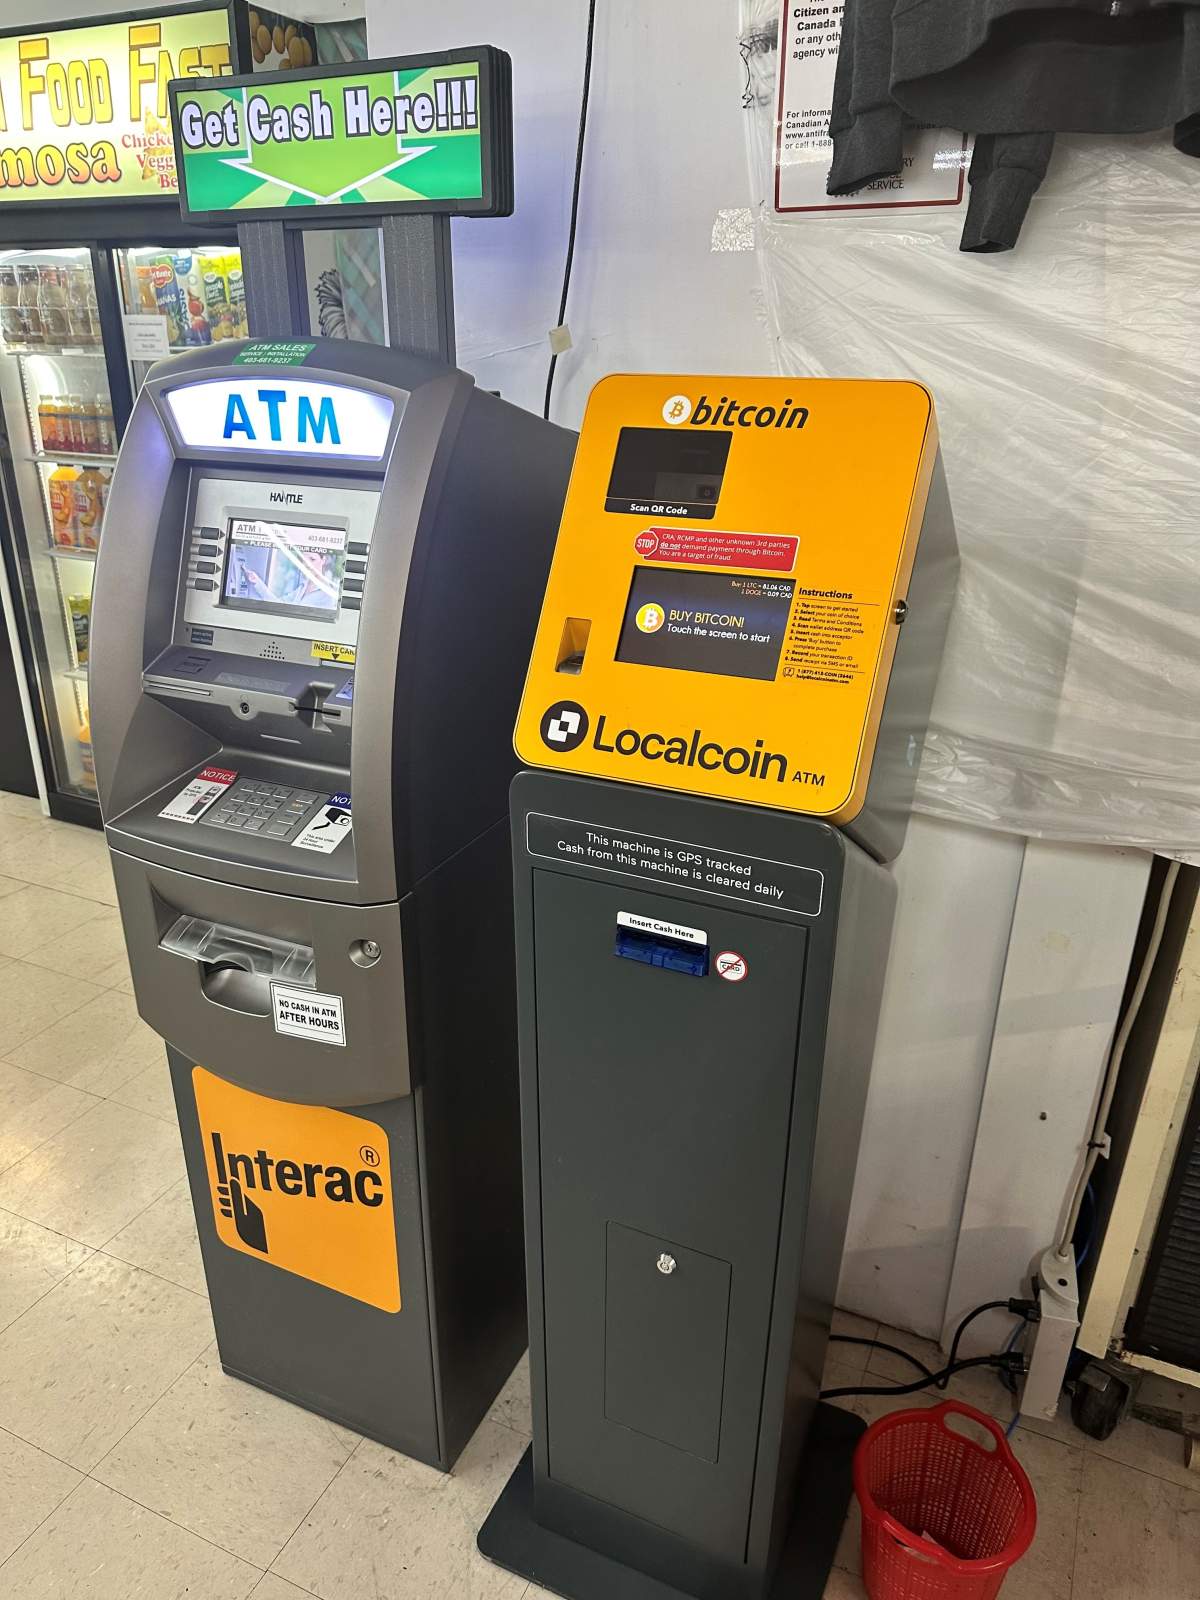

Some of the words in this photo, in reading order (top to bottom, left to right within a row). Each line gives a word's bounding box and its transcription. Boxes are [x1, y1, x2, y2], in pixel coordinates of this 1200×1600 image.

[794, 7, 829, 17] Citizen
[797, 19, 836, 31] Canada
[807, 35, 823, 45] any
[793, 48, 825, 60] agency
[828, 45, 838, 54] wi
[19, 37, 113, 130] FOOD
[180, 99, 239, 149] Get
[248, 89, 334, 144] Cash
[343, 76, 478, 138] Here!!!
[786, 119, 821, 128] Canadian
[795, 141, 809, 149] call
[867, 179, 904, 190] SERVICE
[223, 389, 341, 444] ATM
[690, 396, 809, 428] bitcoin
[630, 503, 649, 512] Scan
[651, 505, 664, 514] QR
[666, 506, 688, 515] Code
[236, 524, 256, 532] ATM
[637, 539, 655, 548] STOP
[736, 547, 760, 555] through
[799, 588, 853, 599] Instructions
[669, 610, 693, 621] BUY
[694, 612, 745, 628] BITCOIN!
[667, 623, 694, 634] Touch
[694, 626, 707, 636] the
[708, 629, 737, 640] screen
[739, 632, 748, 641] to
[750, 633, 770, 643] start
[313, 643, 339, 652] INSERT
[593, 715, 788, 782] Localcoin
[791, 771, 825, 786] ATM
[200, 770, 237, 782] NOTICE
[586, 832, 608, 846] This
[613, 838, 660, 856] machine
[665, 848, 673, 858] is
[677, 851, 702, 865] GPS
[706, 857, 751, 876] tracked
[557, 840, 584, 855] Cash
[587, 847, 613, 862] from
[616, 851, 637, 865] this
[640, 857, 689, 877] machine
[692, 868, 702, 880] is
[705, 872, 750, 890] cleared
[753, 883, 784, 899] daily
[629, 917, 653, 929] Insert
[653, 922, 672, 934] Cash
[674, 927, 694, 939] Here
[279, 999, 290, 1009] NO
[291, 1002, 310, 1013] CASH
[312, 1005, 319, 1015] IN
[321, 1007, 337, 1017] ATM
[279, 1010, 307, 1025] AFTER
[309, 1015, 339, 1030] HOURS
[211, 1133, 384, 1207] Interac
